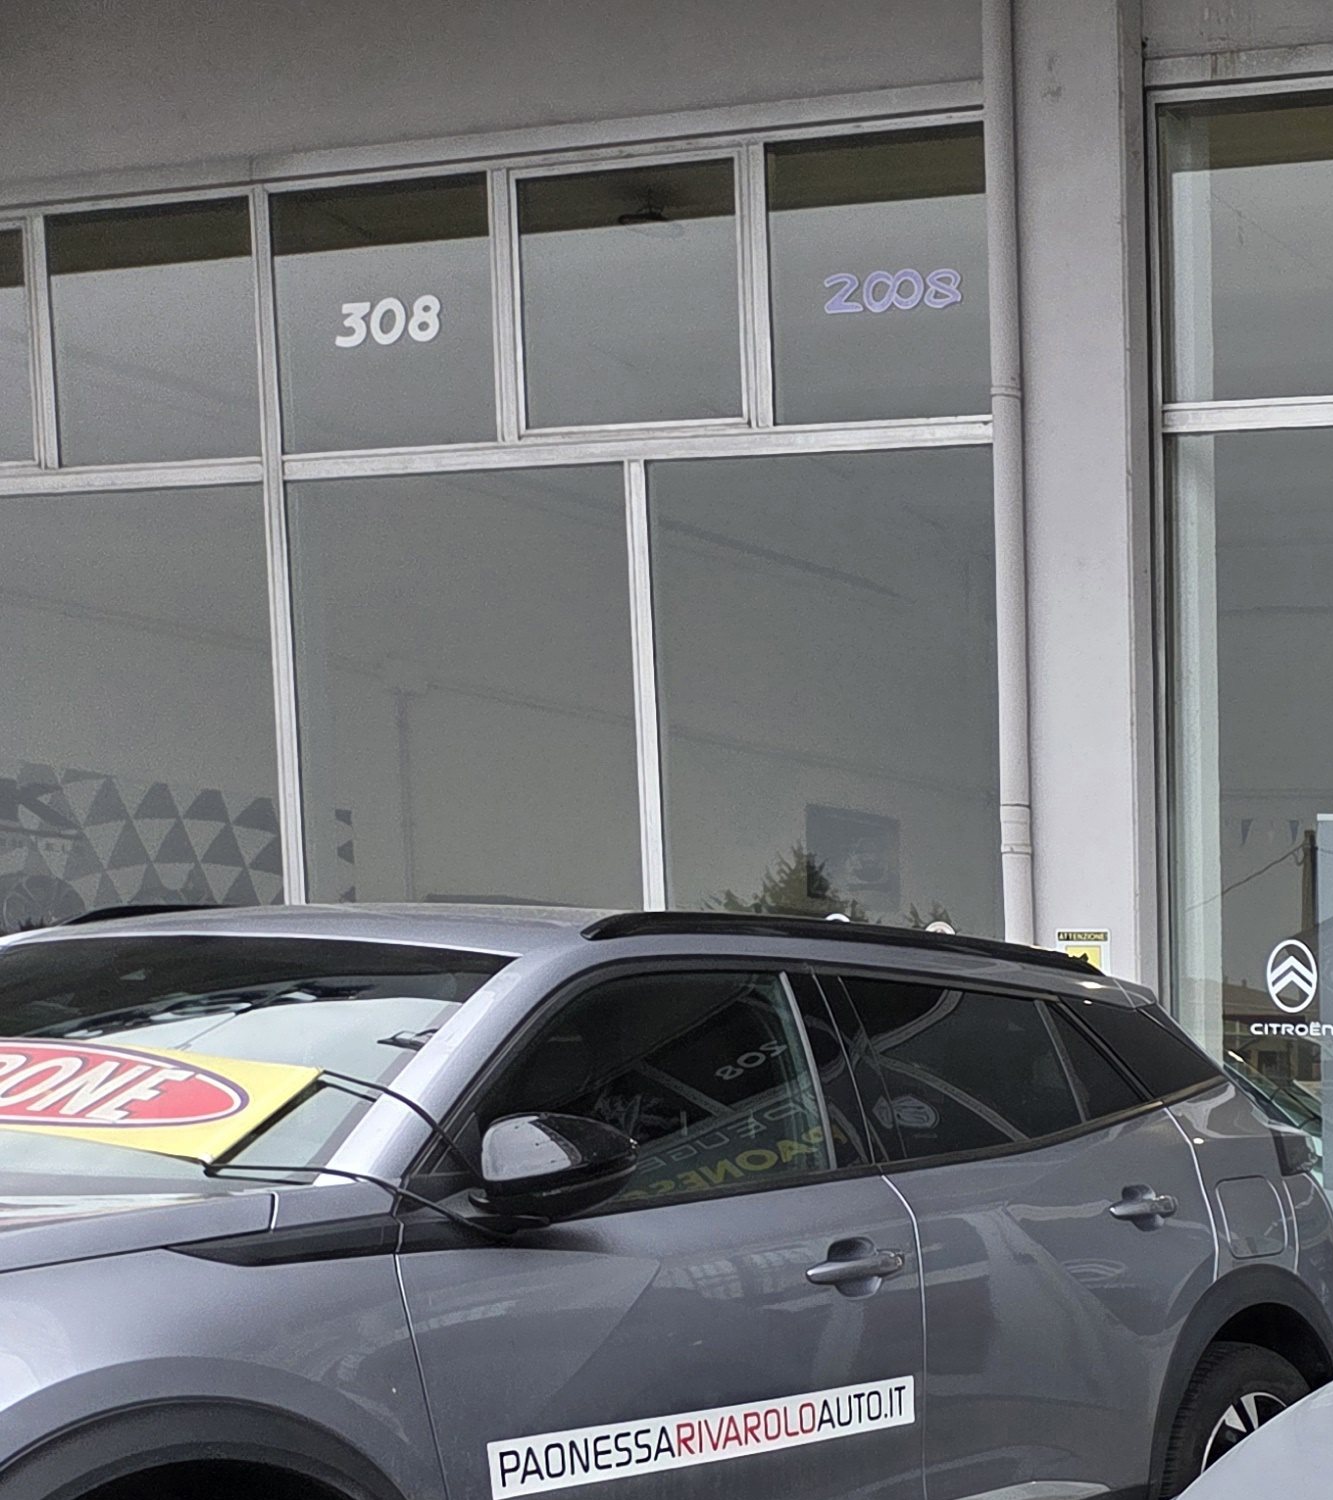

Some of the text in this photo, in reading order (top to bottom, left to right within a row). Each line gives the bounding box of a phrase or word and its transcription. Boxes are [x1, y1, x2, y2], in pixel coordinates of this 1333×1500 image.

[334, 295, 441, 348] 308
[822, 267, 962, 316] 2008
[0, 1053, 195, 1121] ONE
[499, 1385, 907, 1488] PAONESSARIVAROLOAUTO.IT
